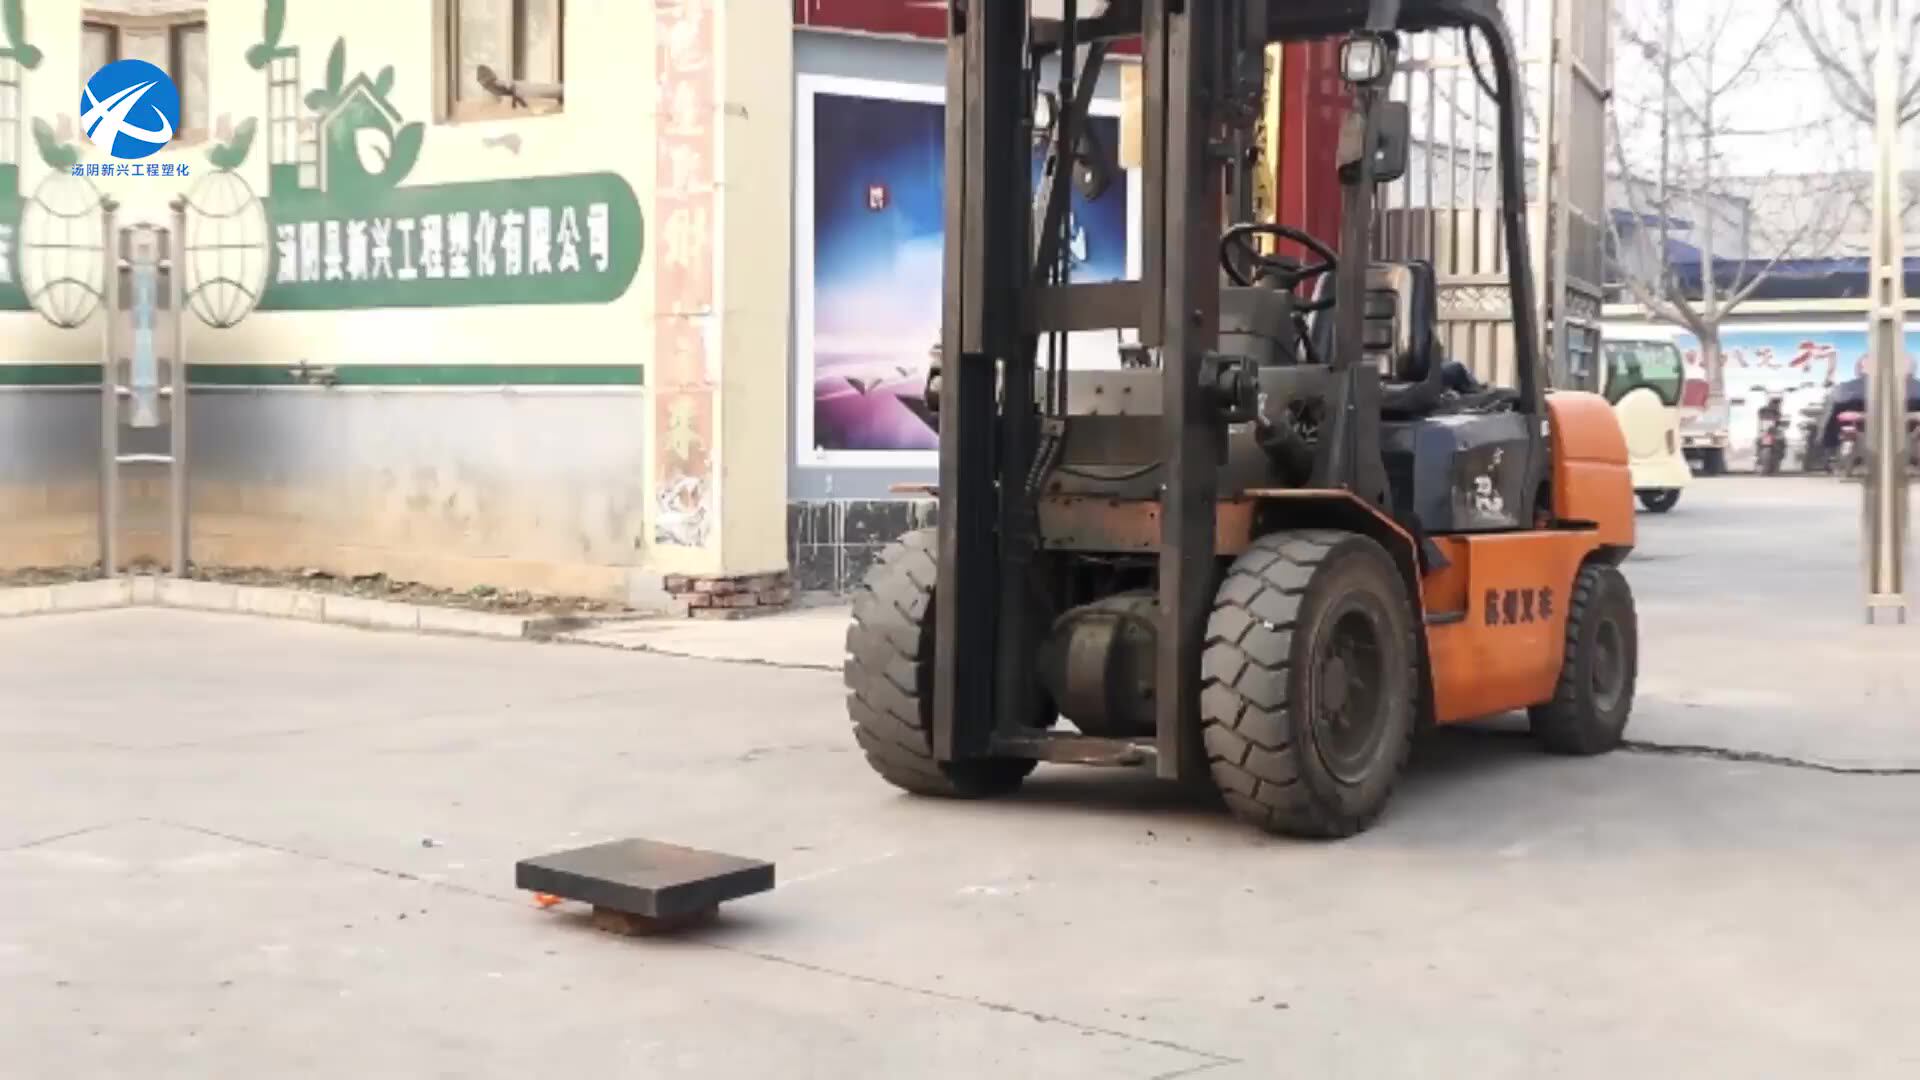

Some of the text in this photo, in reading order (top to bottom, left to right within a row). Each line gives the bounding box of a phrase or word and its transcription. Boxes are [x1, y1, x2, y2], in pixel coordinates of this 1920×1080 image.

[276, 202, 609, 284] 汤阴县新兴工程塑化有限公司
